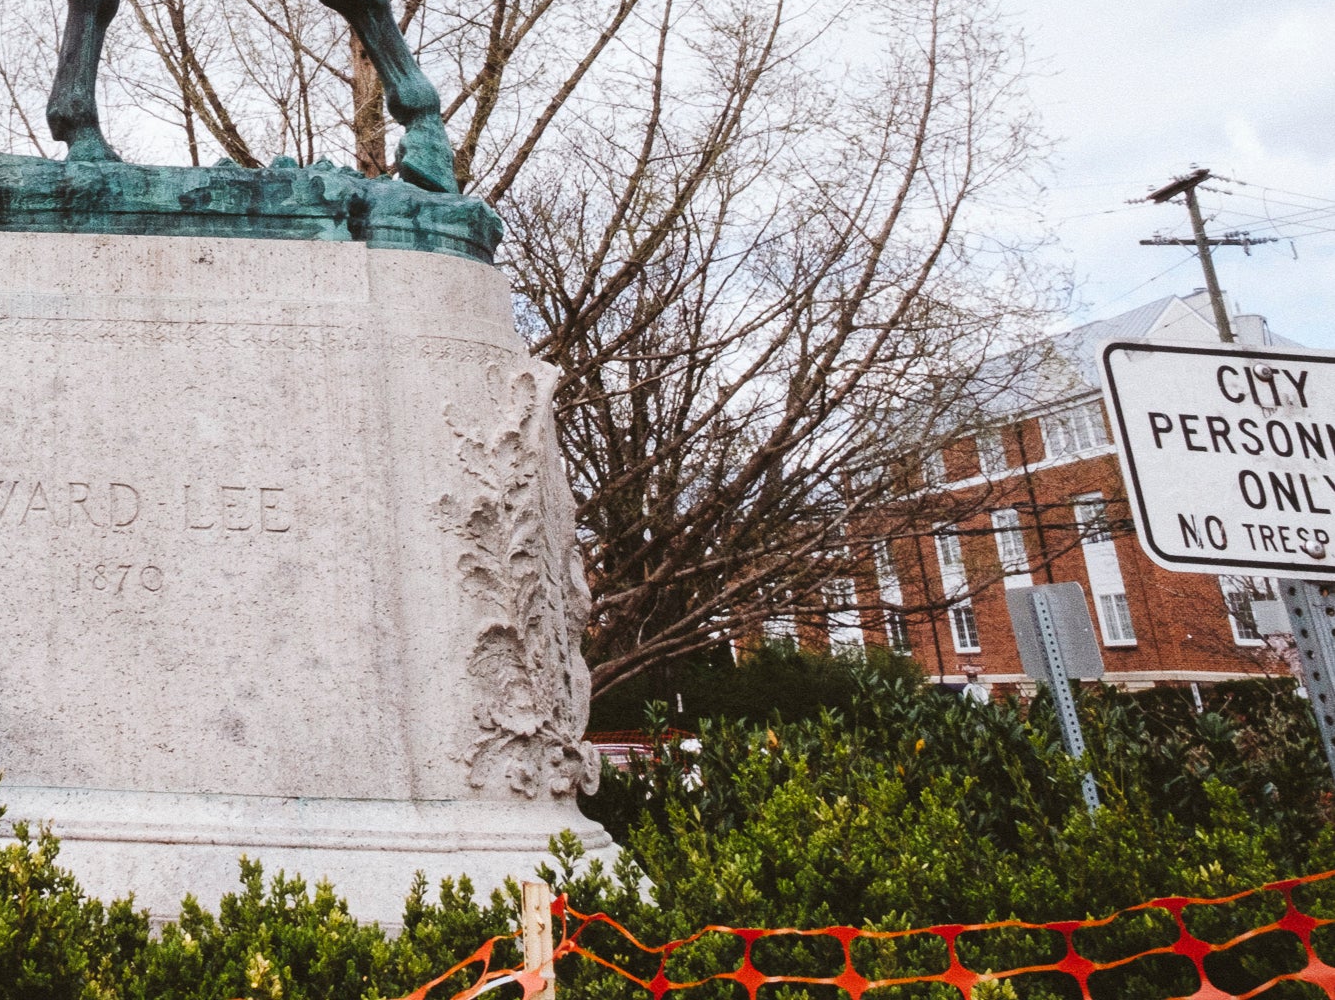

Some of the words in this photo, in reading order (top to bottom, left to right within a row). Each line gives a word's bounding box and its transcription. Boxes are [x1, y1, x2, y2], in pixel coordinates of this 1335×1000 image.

[1216, 365, 1308, 408] CITY
[183, 484, 291, 533] LEE
[1177, 513, 1228, 551] NO
[1241, 523, 1330, 557] TRESP
[73, 562, 165, 596] 1870
